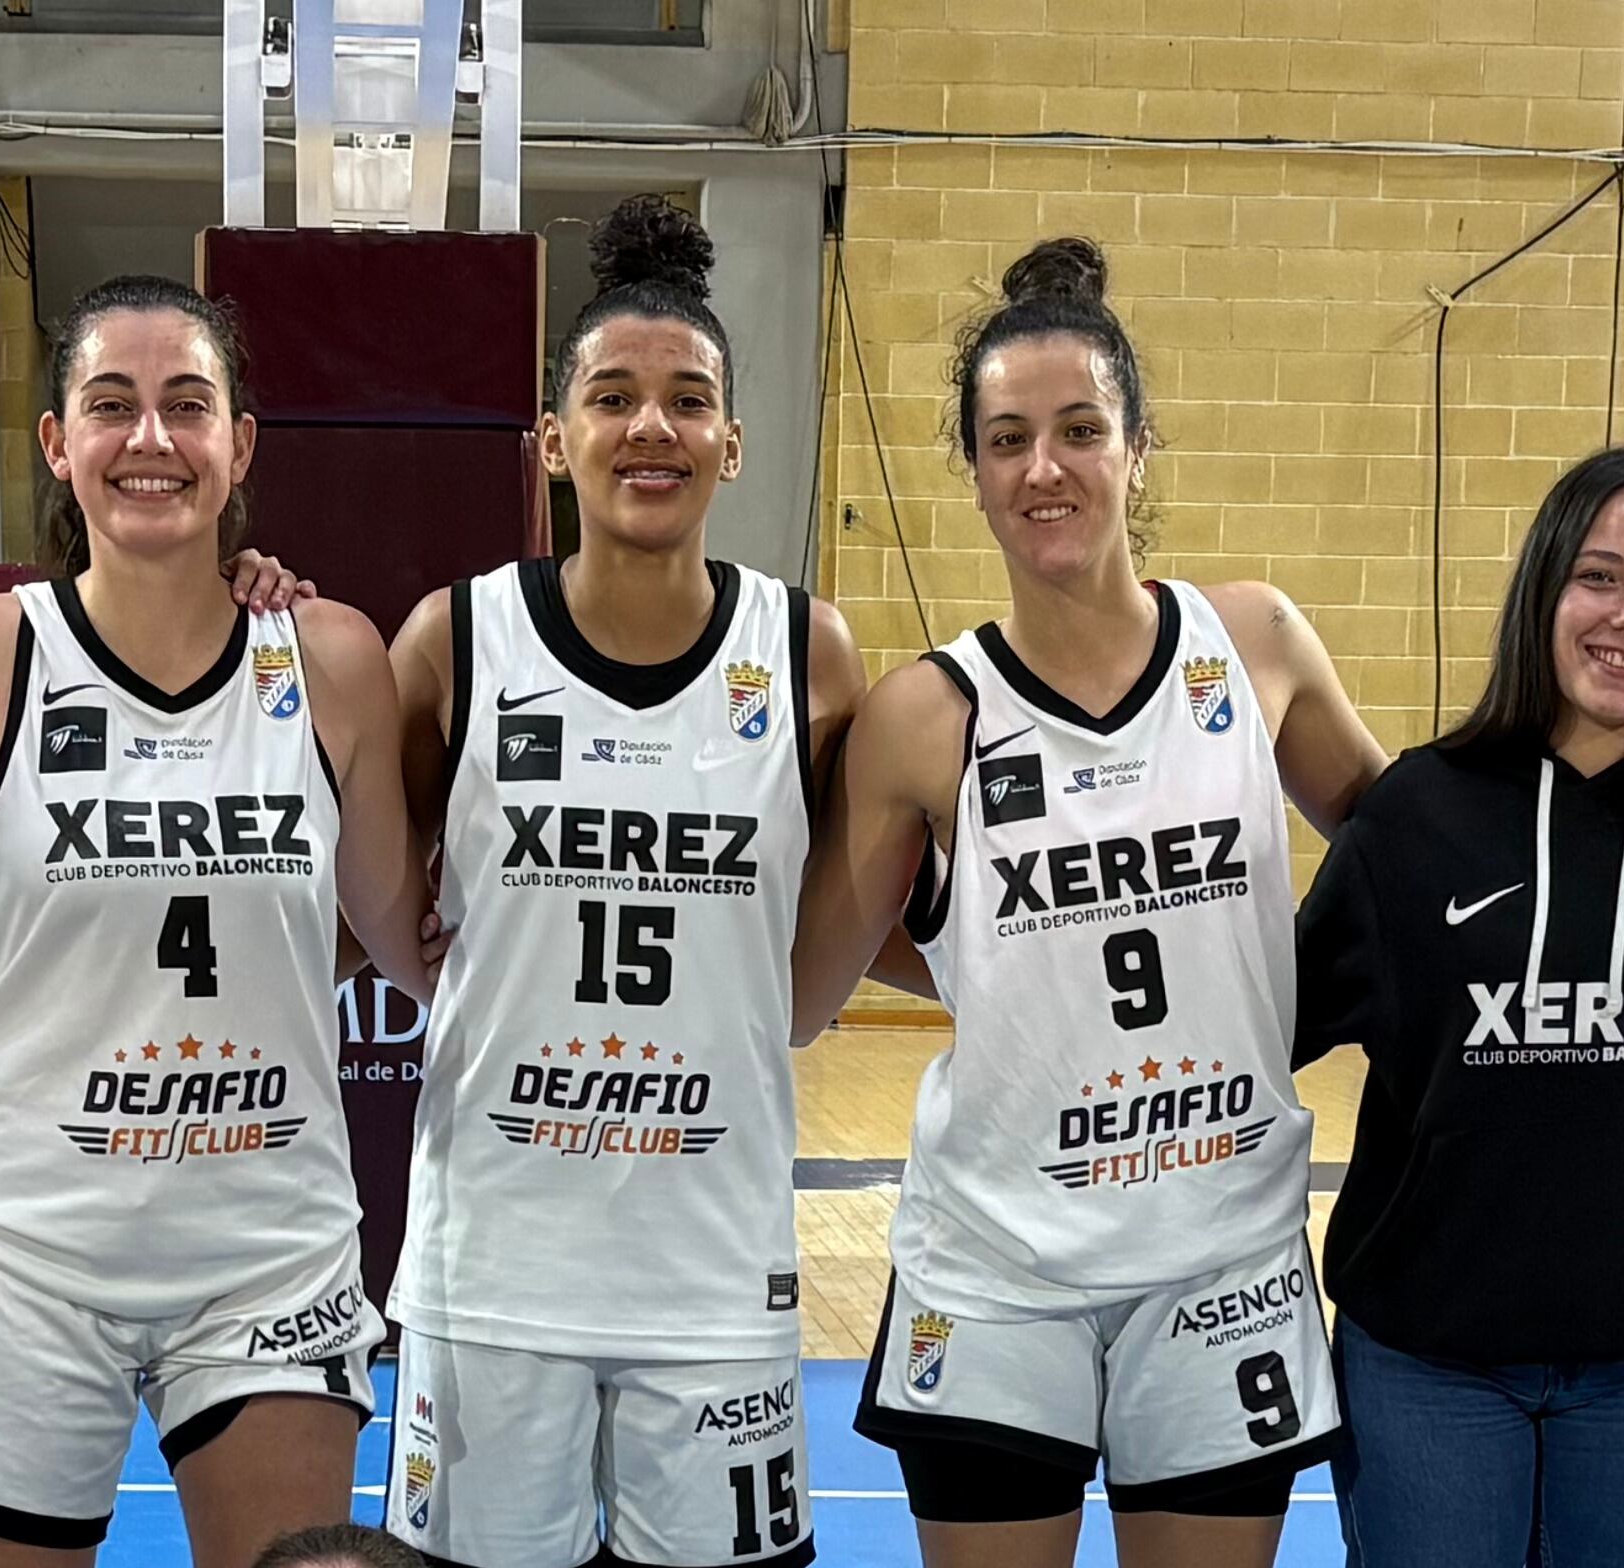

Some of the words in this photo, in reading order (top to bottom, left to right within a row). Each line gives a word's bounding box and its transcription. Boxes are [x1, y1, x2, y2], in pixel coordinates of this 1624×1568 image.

[45, 794, 312, 864] XEREZ
[502, 805, 759, 877] XEREZ
[45, 866, 87, 883] CLUB
[91, 862, 191, 880] DEPORTIVO
[195, 857, 314, 877] BALONCESTO
[502, 873, 541, 887] CLUB
[544, 874, 634, 892] DEPORTIVO
[638, 876, 756, 896] BALONCESTO
[992, 817, 1247, 919] XEREZ
[997, 918, 1038, 937] CLUB
[1041, 903, 1132, 931] DEPORTIVO
[1135, 881, 1249, 915] BALONCESTO
[157, 895, 218, 998] 4
[575, 899, 675, 1007] 15
[1102, 927, 1169, 1031] 9
[365, 1061, 395, 1081] de
[1463, 1050, 1504, 1066] CLUB
[1507, 1048, 1599, 1064] DEPORTIVO
[82, 1065, 288, 1115] DESAFIO
[510, 1063, 711, 1115] DESAFIO
[1058, 1074, 1254, 1152] DESAFIO
[187, 1122, 266, 1156] CLUB
[605, 1122, 681, 1155] CLUB
[1158, 1132, 1235, 1172] CLUB
[1171, 1268, 1303, 1338] ASENCIO
[1205, 1309, 1294, 1348] AUTOMOCIÓN
[694, 1378, 795, 1433] ASENCI
[1235, 1350, 1302, 1448] 9
[729, 1447, 799, 1557] 15
